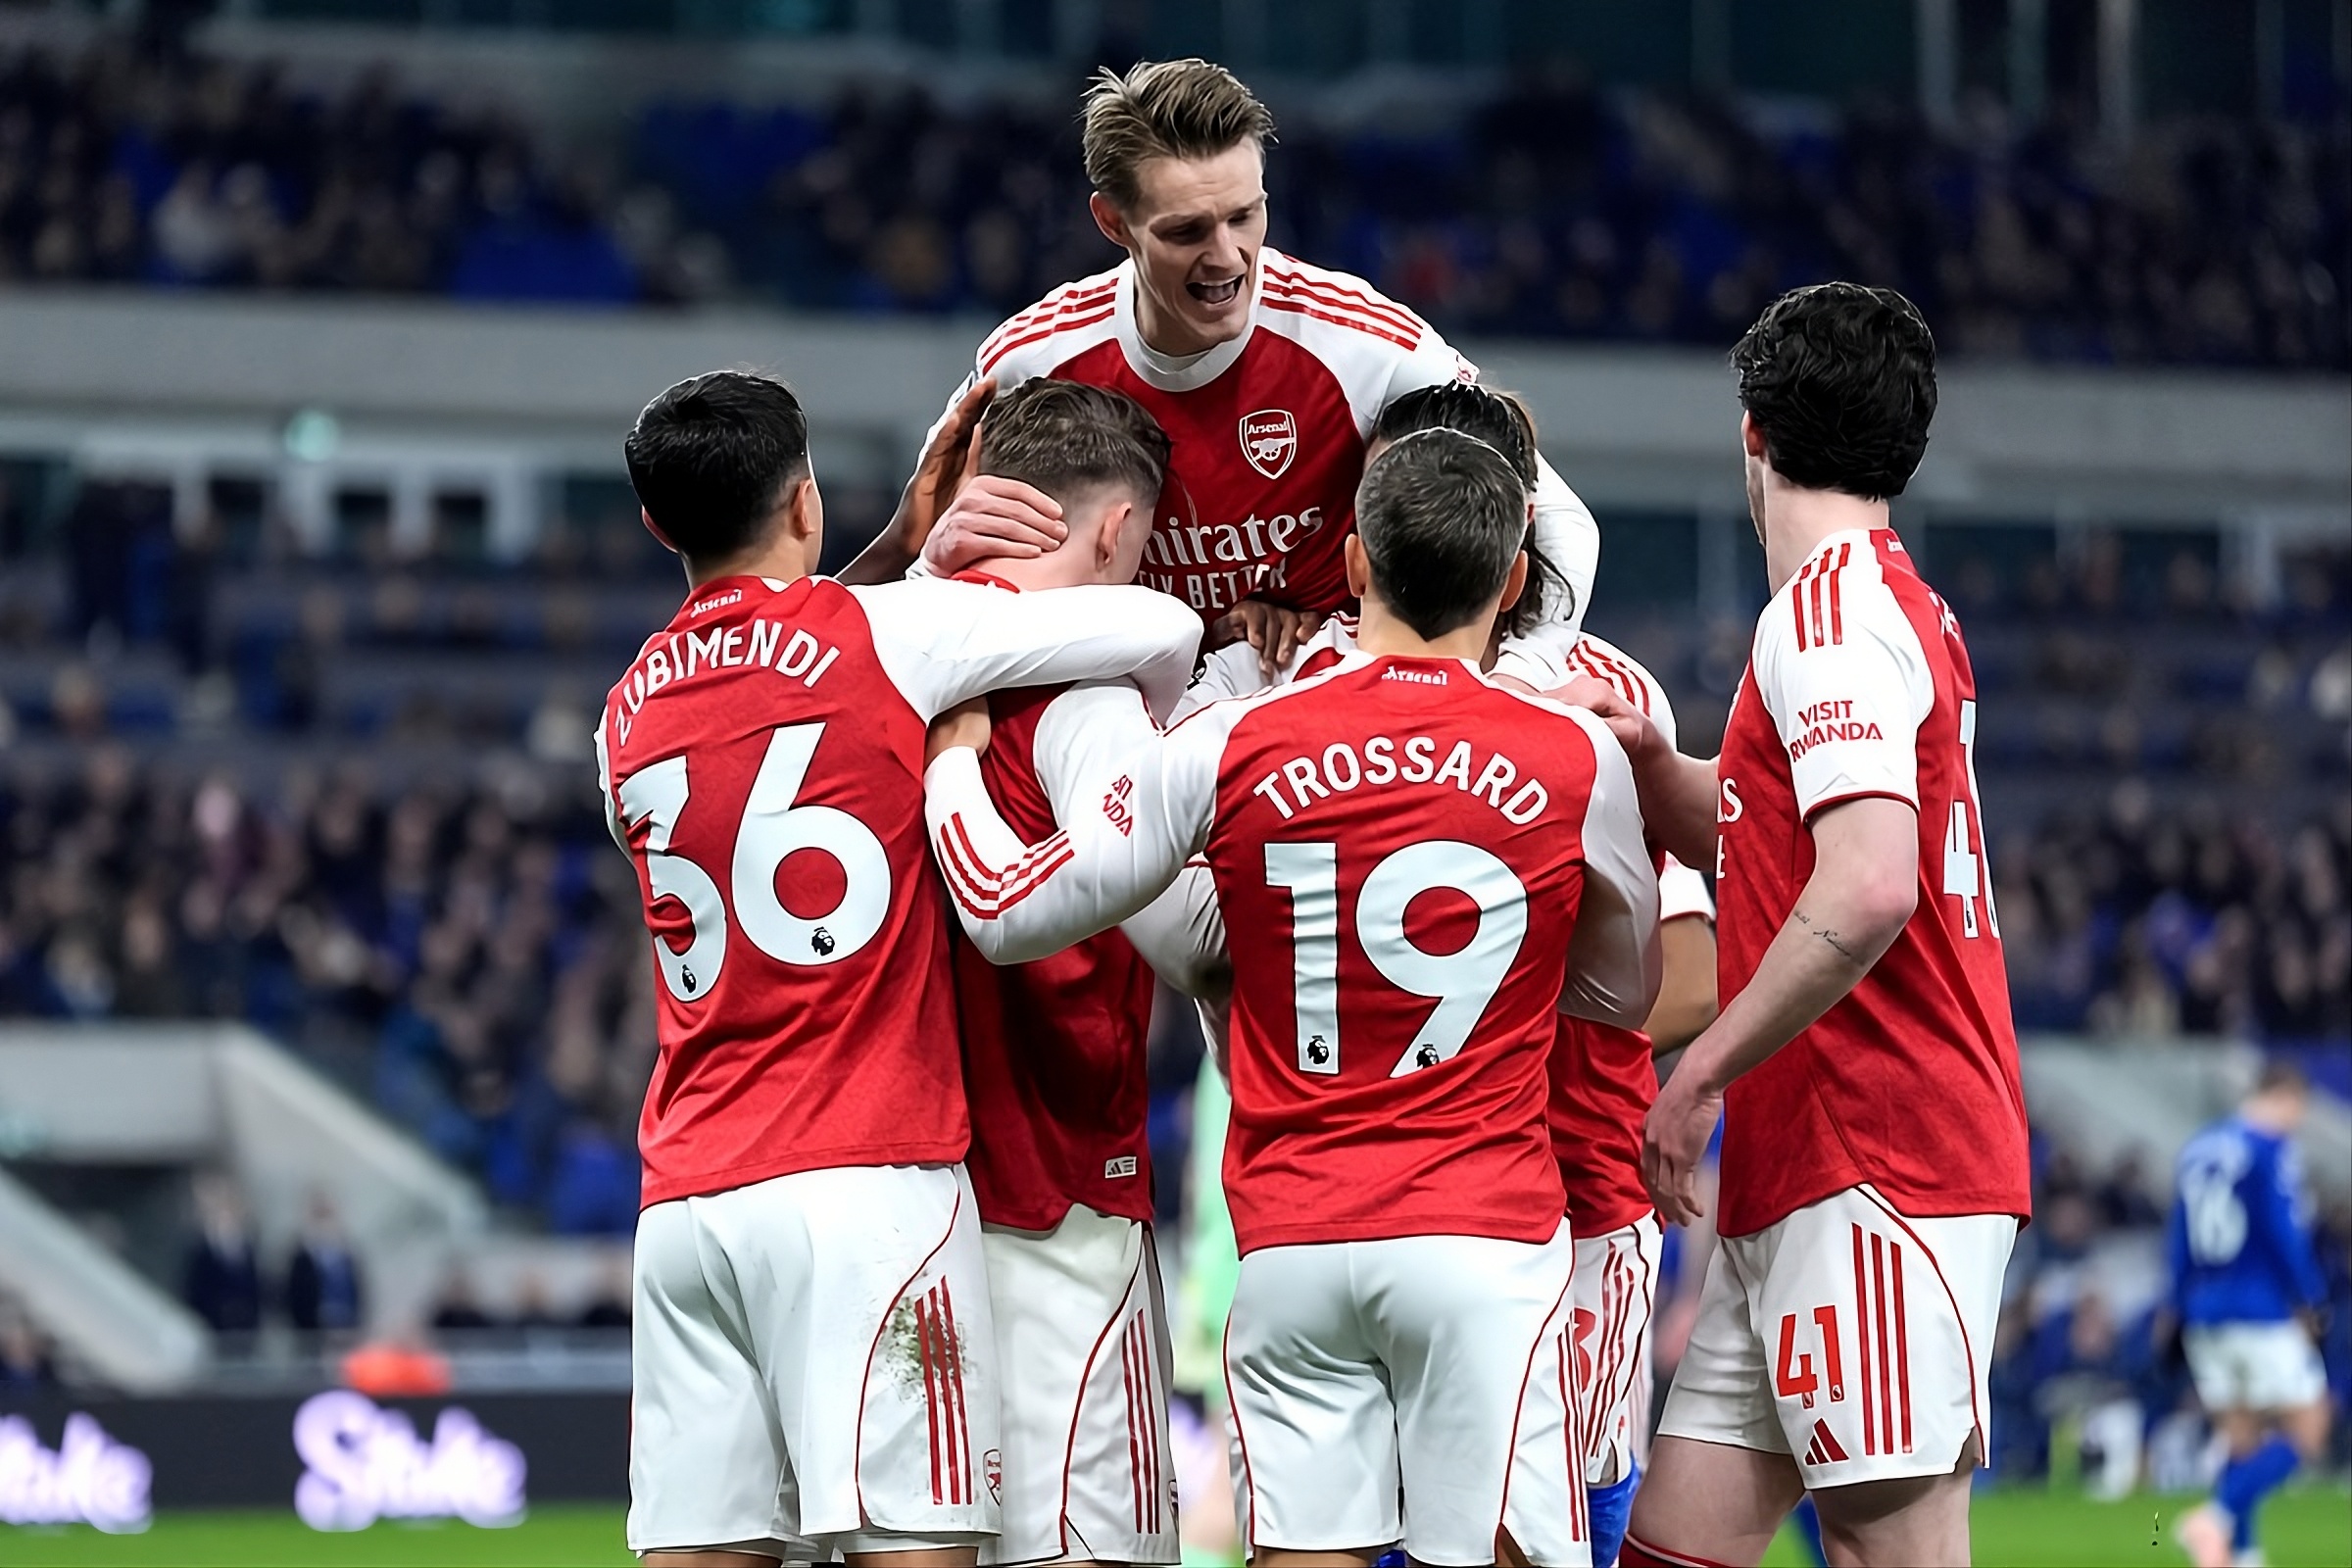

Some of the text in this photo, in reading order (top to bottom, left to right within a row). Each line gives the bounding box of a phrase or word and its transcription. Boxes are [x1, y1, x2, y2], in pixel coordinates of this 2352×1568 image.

[1247, 420, 1288, 434] Arsenal
[690, 588, 743, 618] Arsenal
[614, 618, 841, 747] ZUBIMENDI
[1381, 665, 1448, 686] Arsenal
[1788, 721, 1884, 762] RWANDA
[1797, 699, 1853, 727] VISIT
[1253, 736, 1548, 825] TROSSARD
[617, 721, 892, 1003] 36
[1264, 840, 1529, 1078] 19
[1776, 1304, 1845, 1410] 41
